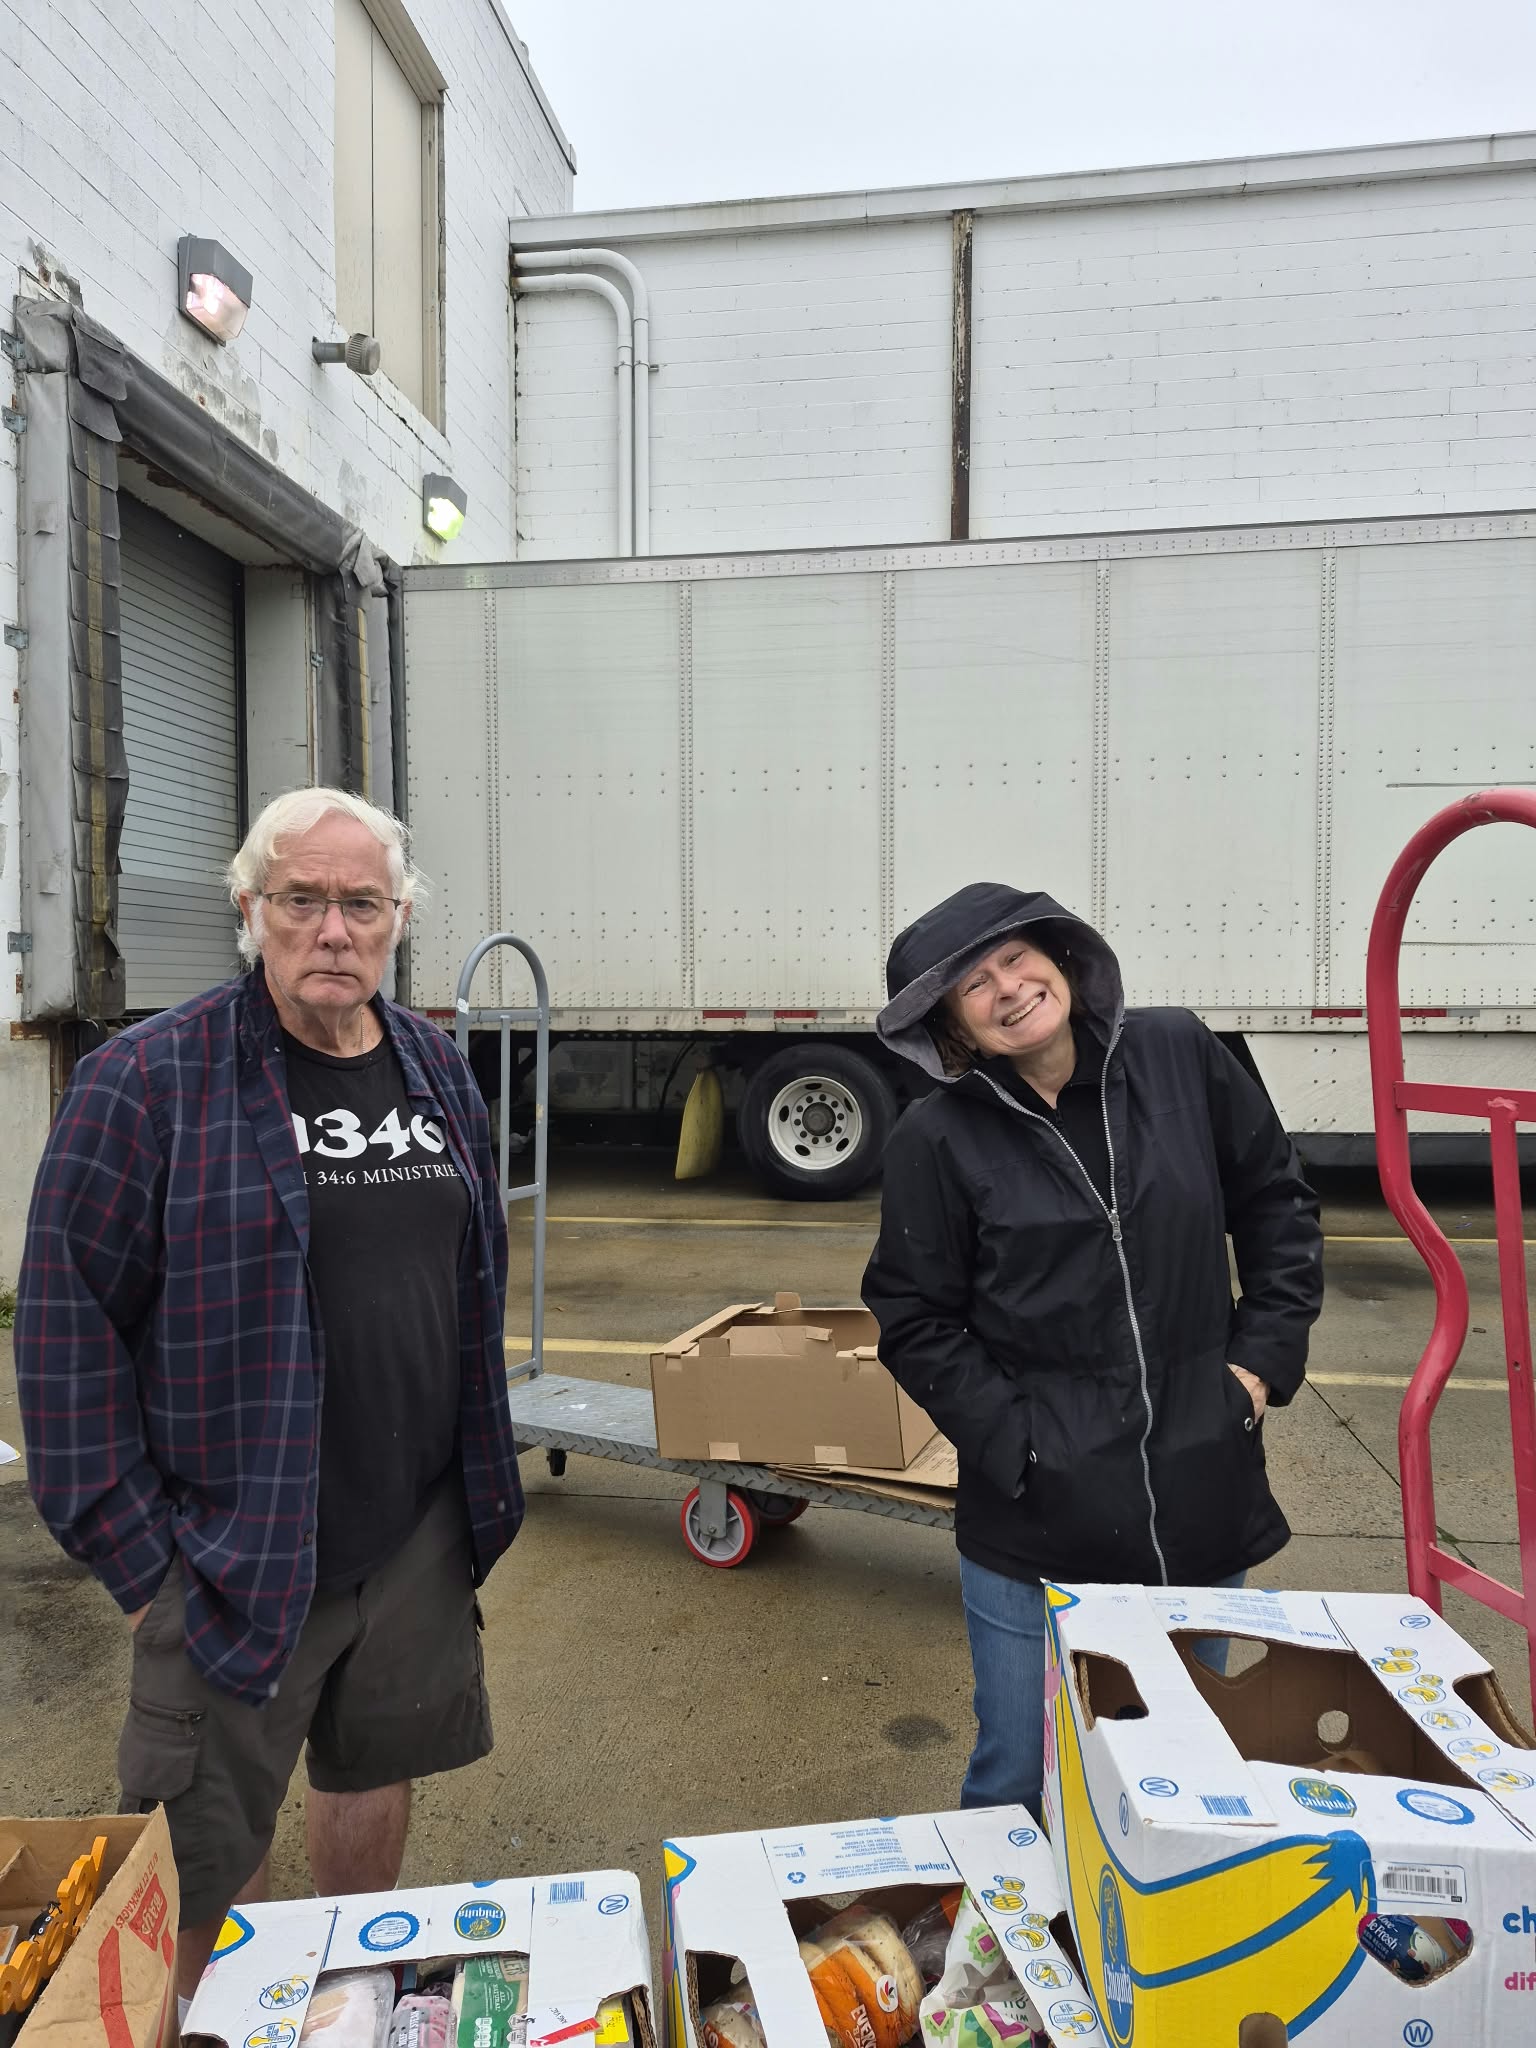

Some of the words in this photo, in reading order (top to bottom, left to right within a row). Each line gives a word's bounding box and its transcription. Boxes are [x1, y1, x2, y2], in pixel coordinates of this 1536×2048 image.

[317, 1169, 356, 1185] 34:6
[914, 1861, 950, 1874] Chiquita
[115, 1882, 144, 1929] PACKAGES
[457, 1906, 504, 1919] Chiquita
[1374, 1926, 1398, 1950] Fresh
[1103, 1962, 1133, 2014] Chiquita
[1408, 2025, 1429, 2043] W
